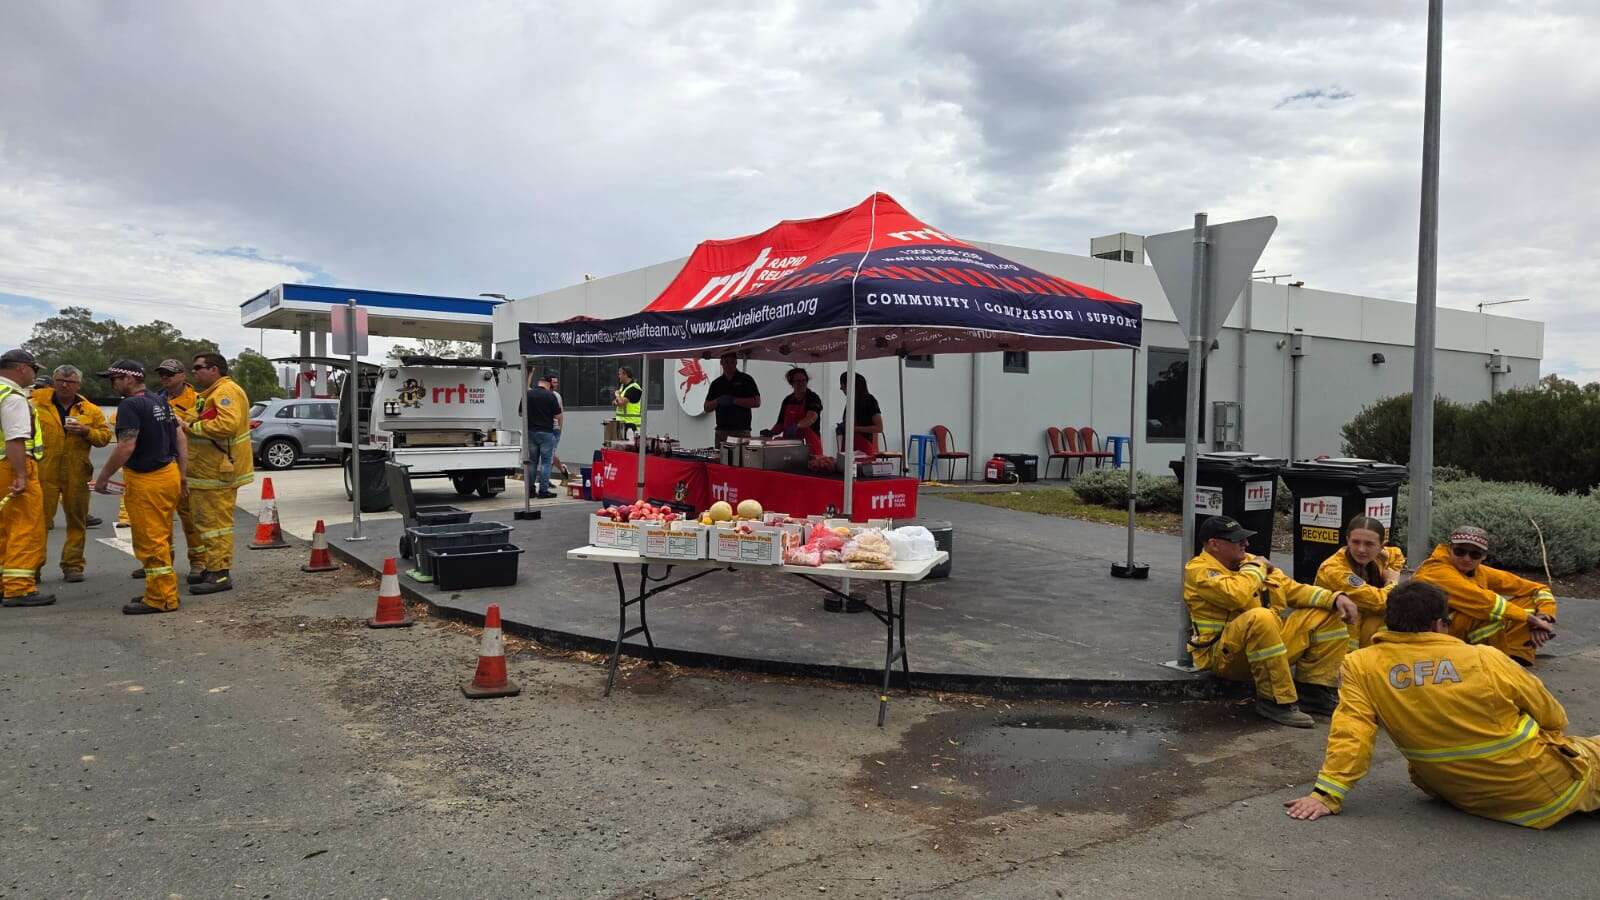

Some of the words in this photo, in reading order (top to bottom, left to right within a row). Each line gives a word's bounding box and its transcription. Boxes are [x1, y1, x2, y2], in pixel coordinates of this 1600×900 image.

[768, 255, 808, 269] RAPID
[682, 247, 773, 310] rrt
[690, 297, 819, 334] www.rapidreliefteam.org
[867, 293, 970, 309] COMMUNITY
[984, 302, 1074, 321] COMPASSION
[1086, 311, 1138, 329] SUPPORT
[432, 384, 468, 404] rrt
[872, 491, 895, 509] rrt
[1247, 485, 1264, 500] rrt
[1303, 501, 1326, 514] rrt
[1368, 503, 1384, 516] rrt
[1302, 528, 1339, 541] RECYCLE
[1389, 658, 1462, 690] CFA
